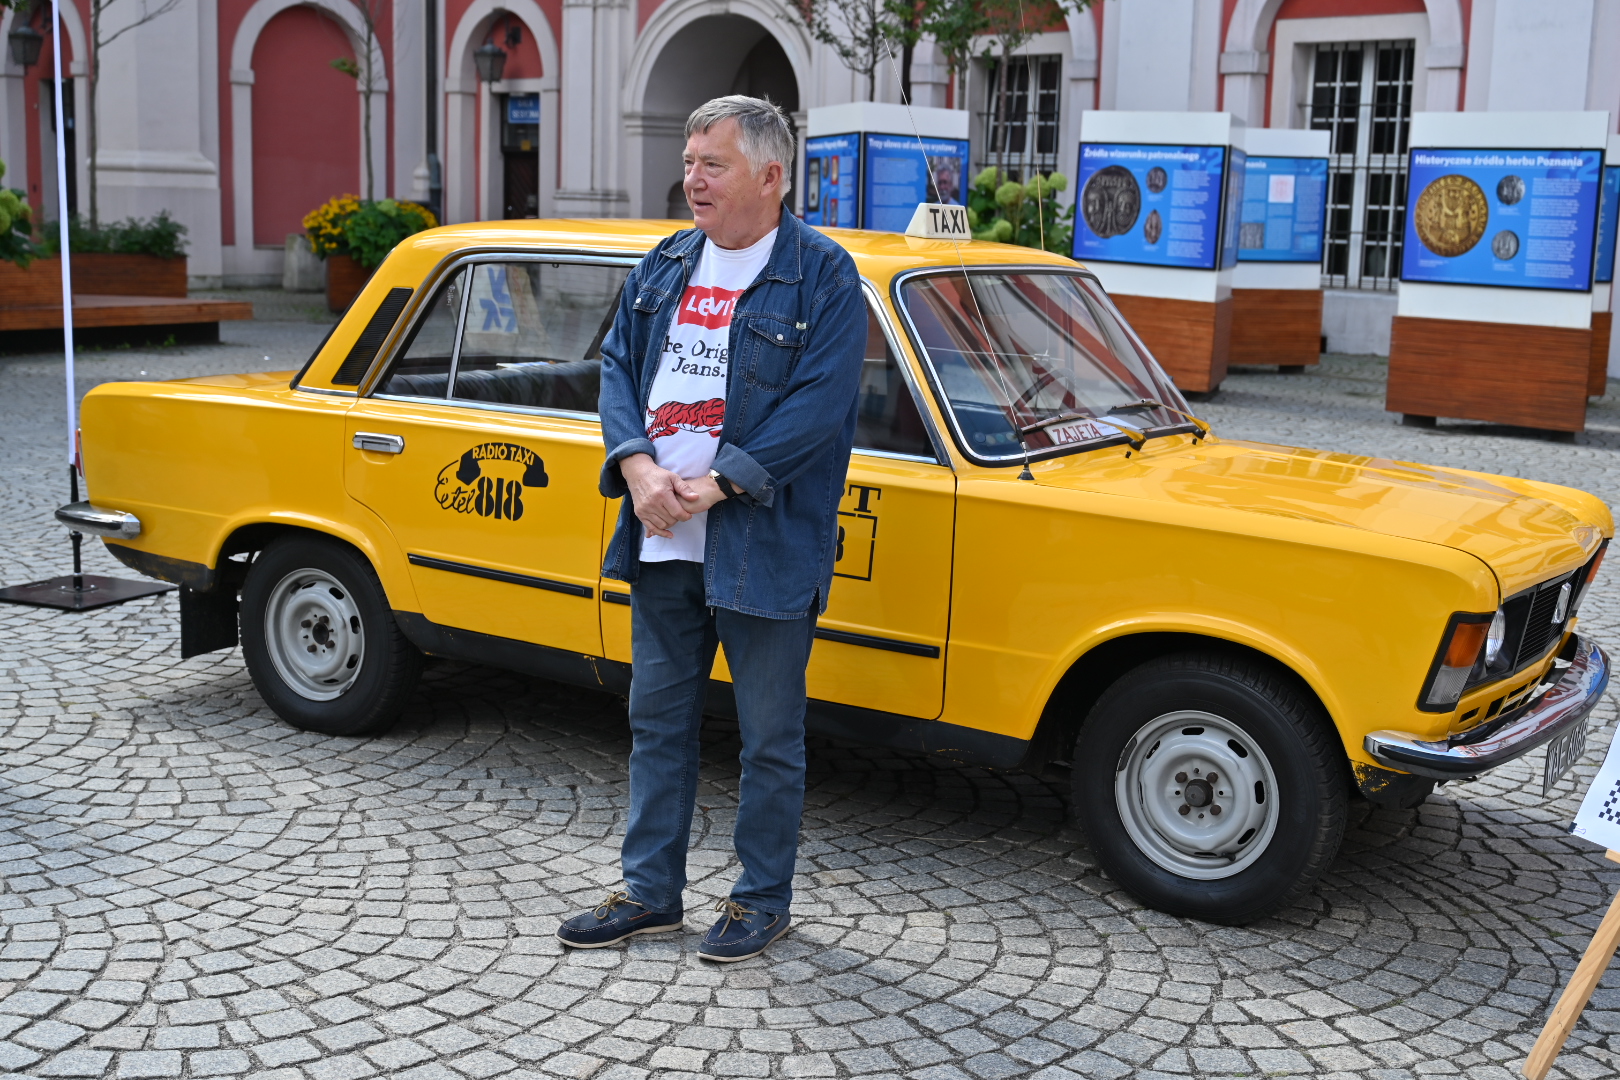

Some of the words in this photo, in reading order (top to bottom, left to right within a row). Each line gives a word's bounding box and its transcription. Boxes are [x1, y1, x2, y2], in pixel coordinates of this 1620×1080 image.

[1109, 149, 1147, 159] wizerunku
[1147, 150, 1200, 162] patronalnego
[1415, 154, 1472, 167] Historyczne
[1506, 155, 1535, 167] herbu
[1536, 156, 1583, 167] Poznania
[929, 208, 966, 234] TAXI
[685, 294, 736, 317] Levi'
[662, 335, 683, 354] he
[691, 339, 728, 364] Orig
[671, 356, 726, 378] Jeans.
[472, 444, 508, 460] RADIO
[510, 447, 535, 466] TAXI
[474, 476, 524, 522] 818
[1546, 735, 1568, 788] WAE
